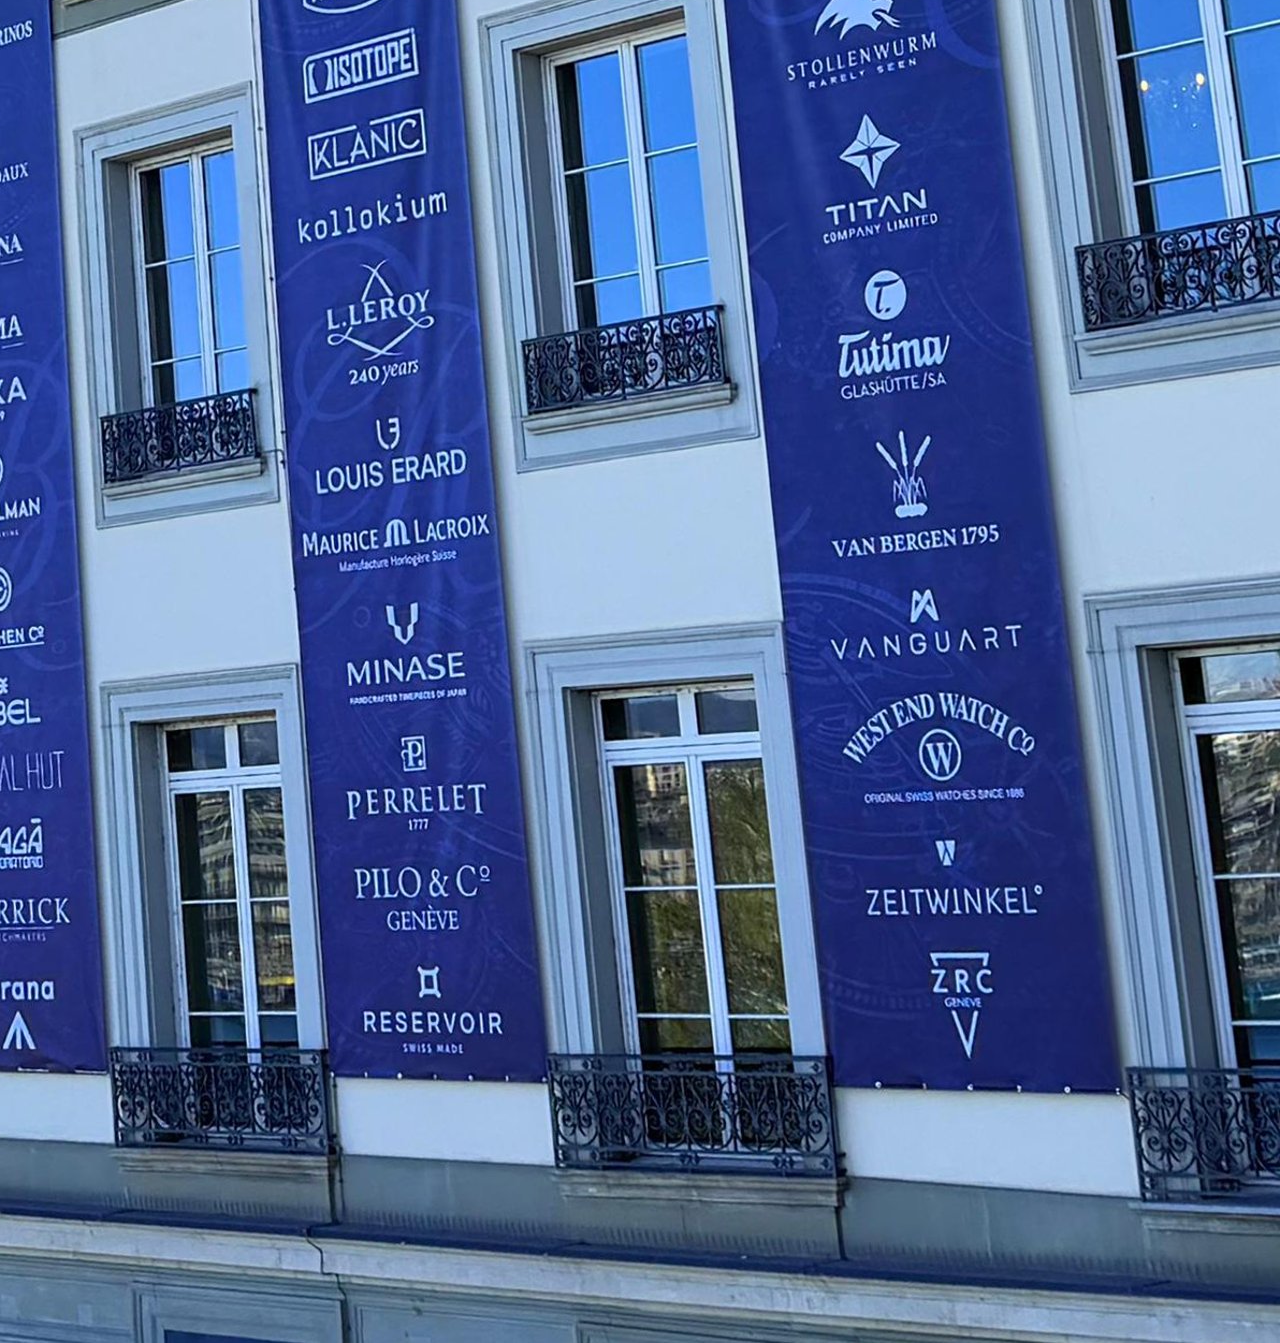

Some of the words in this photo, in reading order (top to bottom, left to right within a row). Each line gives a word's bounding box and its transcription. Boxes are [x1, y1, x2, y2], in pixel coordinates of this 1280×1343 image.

[333, 37, 412, 89] ISOTOPE
[787, 31, 938, 82] STOLLENWURM
[808, 69, 866, 89] RARELY
[877, 57, 917, 74] SEEN
[313, 118, 420, 171] KLANIC
[298, 191, 448, 244] kollokium
[825, 188, 928, 226] TITAN
[823, 223, 881, 244] COMPANY
[887, 212, 938, 232] LIMITED
[838, 330, 950, 378] Tutima
[349, 365, 380, 385] 240
[381, 358, 419, 385] years
[316, 461, 384, 495] LOUIS
[391, 448, 467, 484] ERARD
[432, 549, 457, 562] Suisse
[831, 537, 876, 558] VAN
[880, 528, 957, 554] BERGEN
[961, 524, 1000, 546] 1795
[831, 624, 1022, 660] VANGUART
[347, 651, 466, 687] MINASE
[843, 708, 894, 764] WEST
[890, 693, 935, 728] END
[938, 692, 1010, 739] WATCH
[346, 784, 486, 820] PERRELET
[864, 791, 905, 804] ORIGINAL
[905, 790, 934, 802] SWISS
[936, 789, 976, 801] WATCHES
[977, 788, 1005, 800] SINCE
[408, 818, 429, 831] 1777
[354, 865, 422, 899] PILO
[428, 868, 449, 898] &
[387, 905, 460, 931] GENÈVE
[930, 969, 993, 993] ZRC
[363, 1011, 503, 1035] RESERVOIR
[402, 1043, 433, 1054] SWISS
[436, 1043, 464, 1054] MADE
